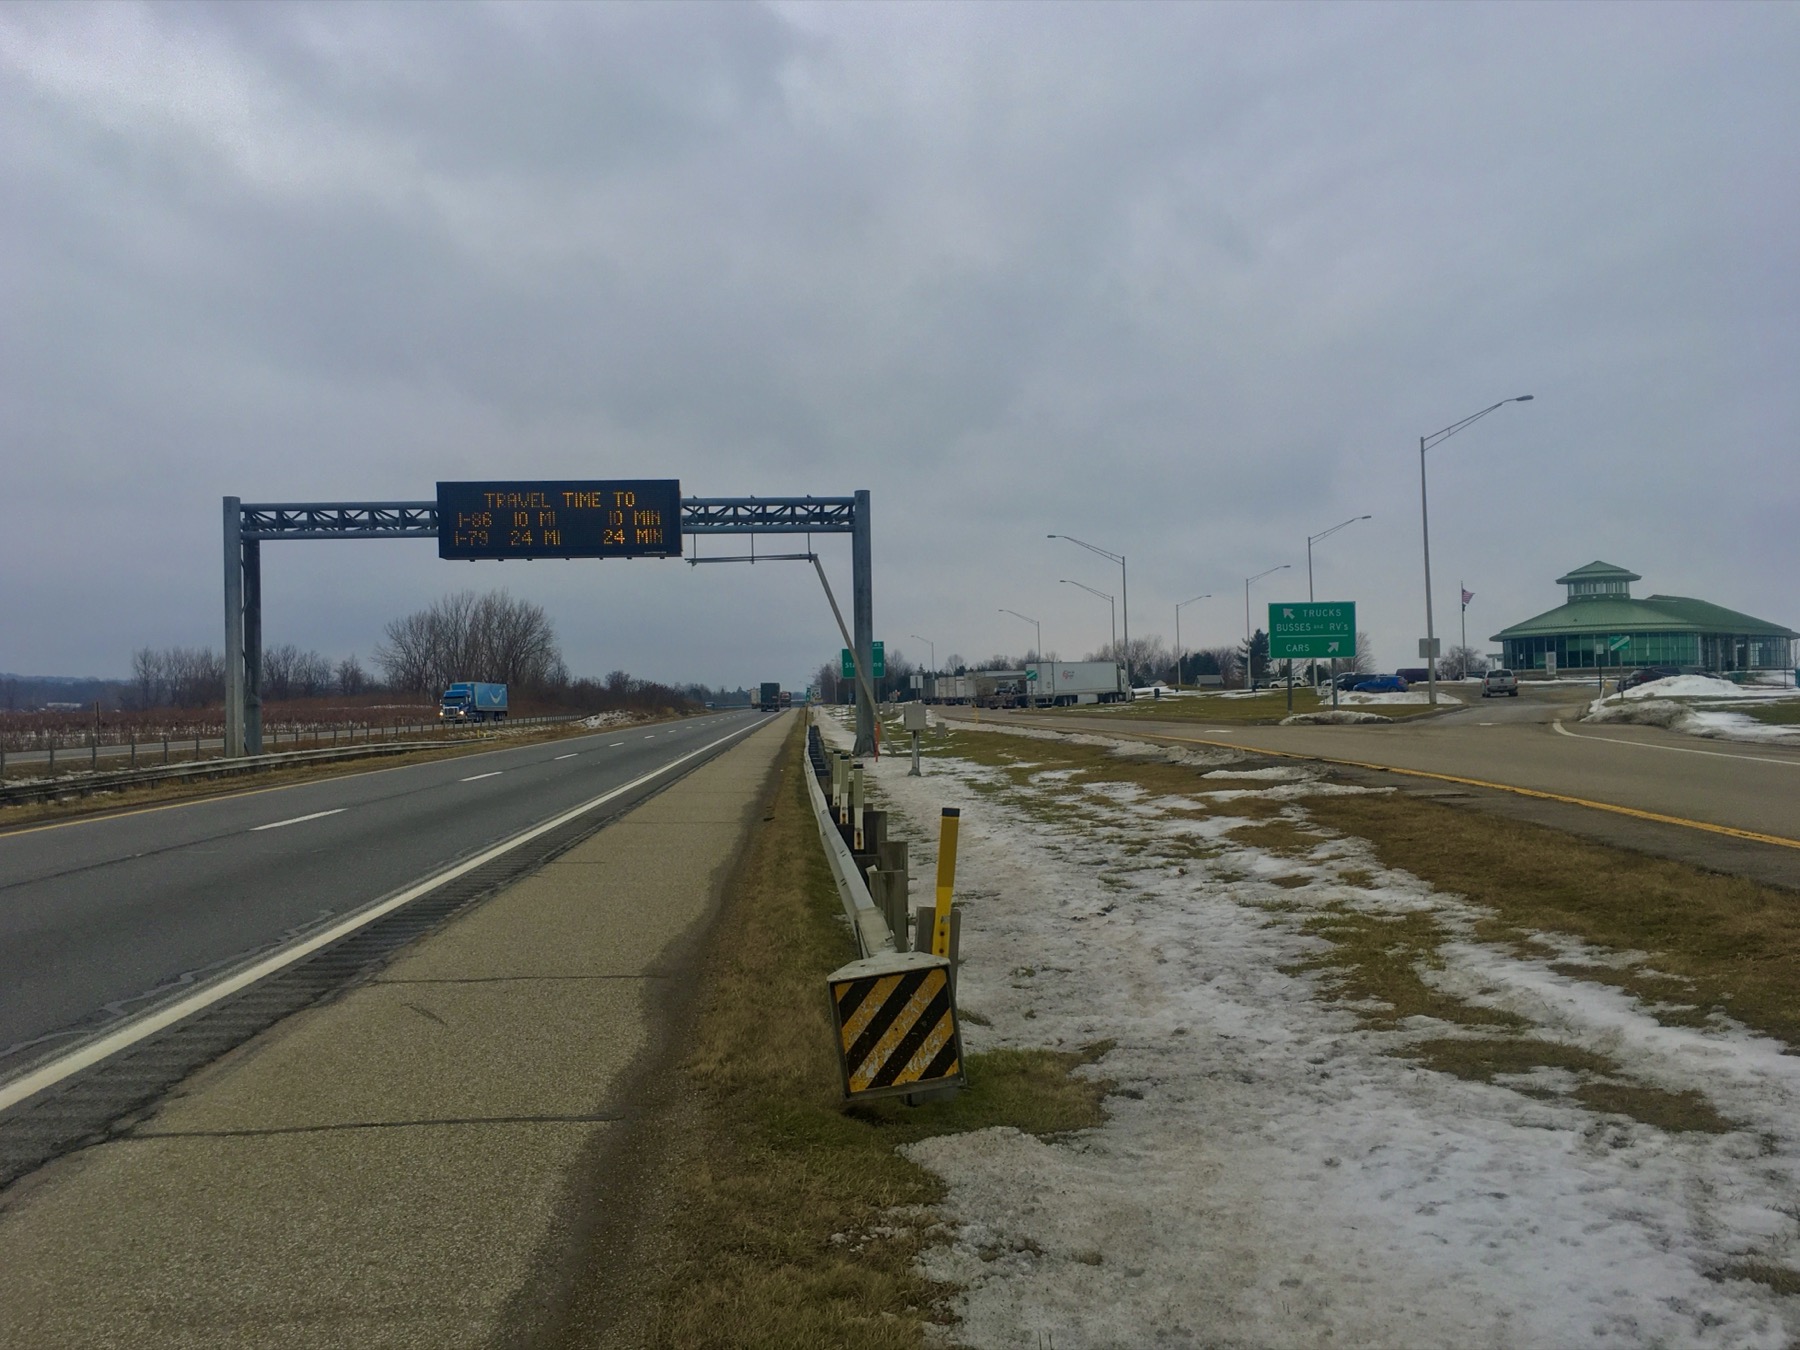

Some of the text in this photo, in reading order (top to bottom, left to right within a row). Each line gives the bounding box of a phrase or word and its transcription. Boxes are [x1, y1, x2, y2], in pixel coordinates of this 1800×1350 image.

[484, 491, 635, 508] TRAVEL TIME TO
[458, 510, 661, 528] I-86 10 MI 10 MIN
[455, 528, 663, 546] I-79 24 MI 24 MIN
[1303, 609, 1342, 617] TRUCKS
[1276, 623, 1311, 632] BUSSES
[1286, 644, 1310, 652] CARS
